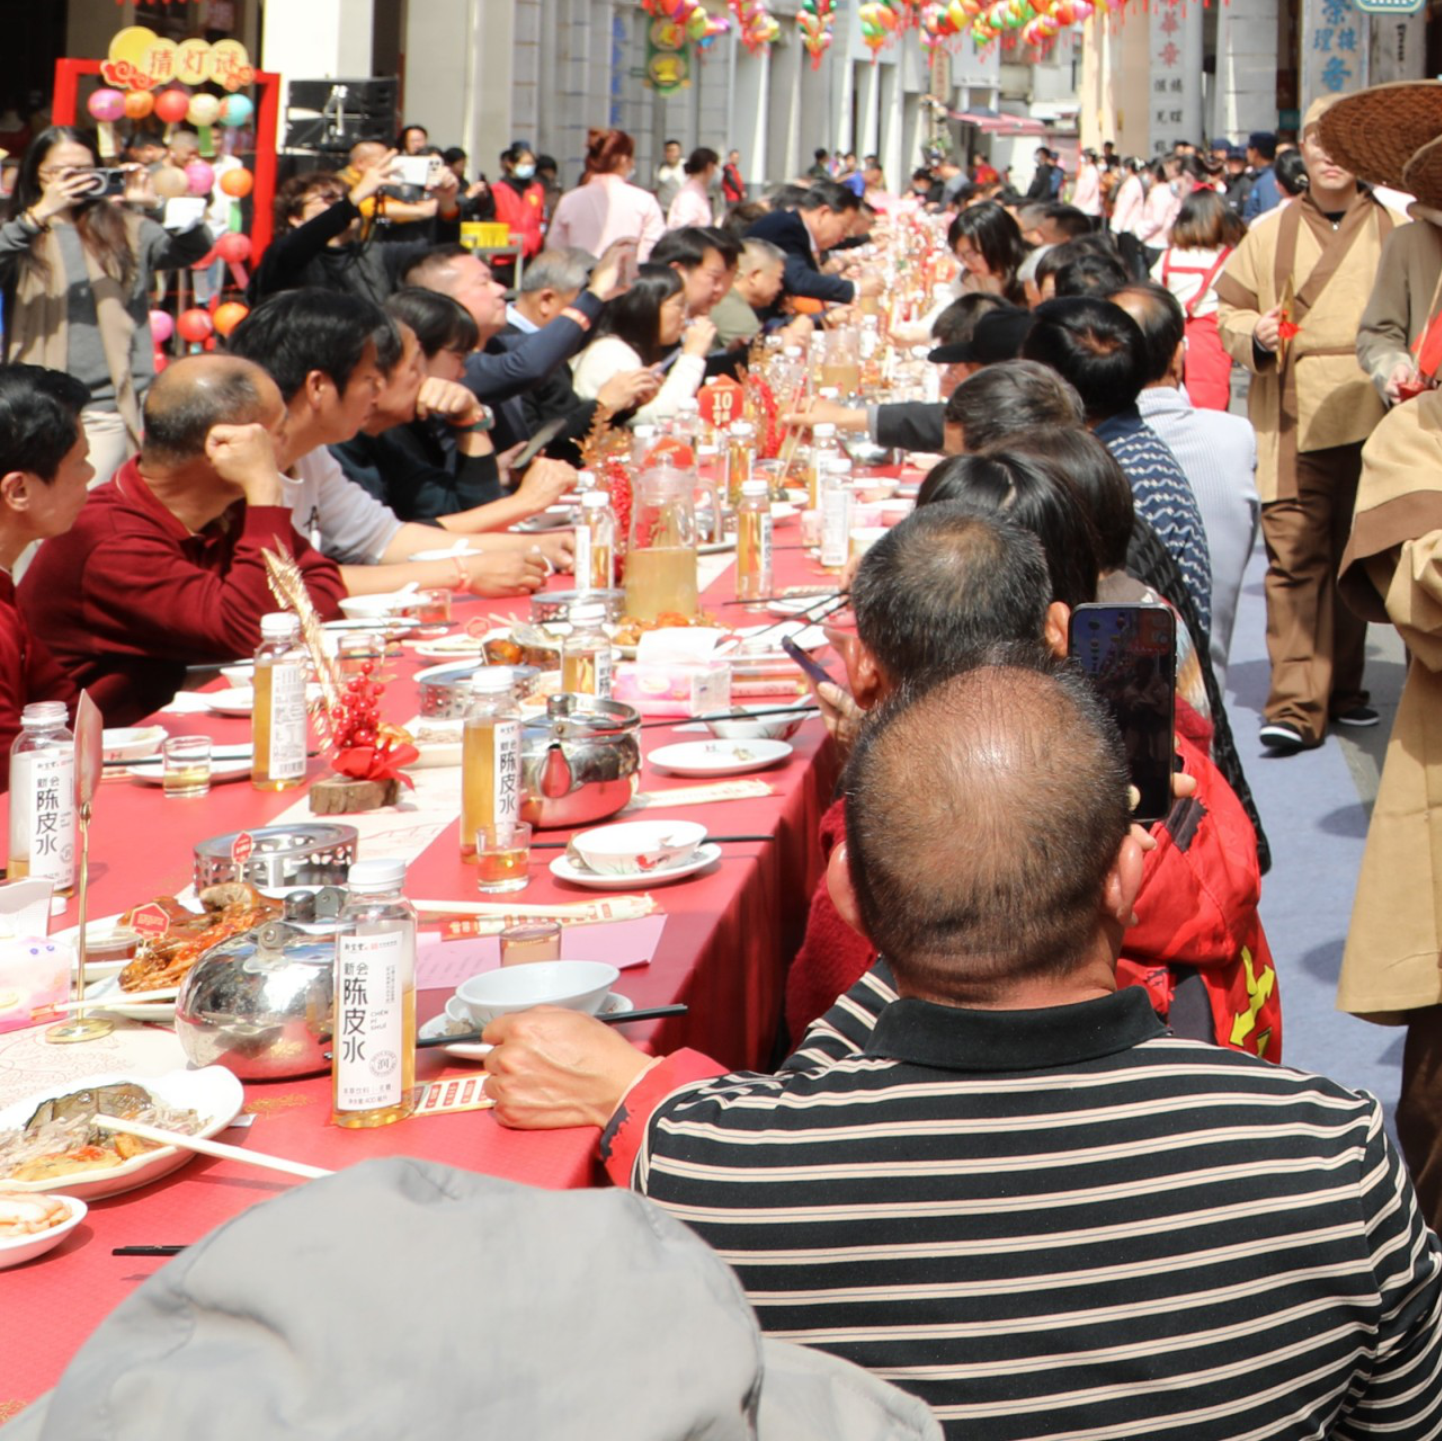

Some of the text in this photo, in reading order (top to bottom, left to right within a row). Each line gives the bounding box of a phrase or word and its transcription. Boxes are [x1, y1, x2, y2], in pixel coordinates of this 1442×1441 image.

[712, 391, 734, 410] 10
[499, 751, 517, 815] 陈皮水
[35, 788, 60, 856] 陈皮水
[344, 961, 369, 977] 新会
[342, 976, 369, 1064] 陈皮水
